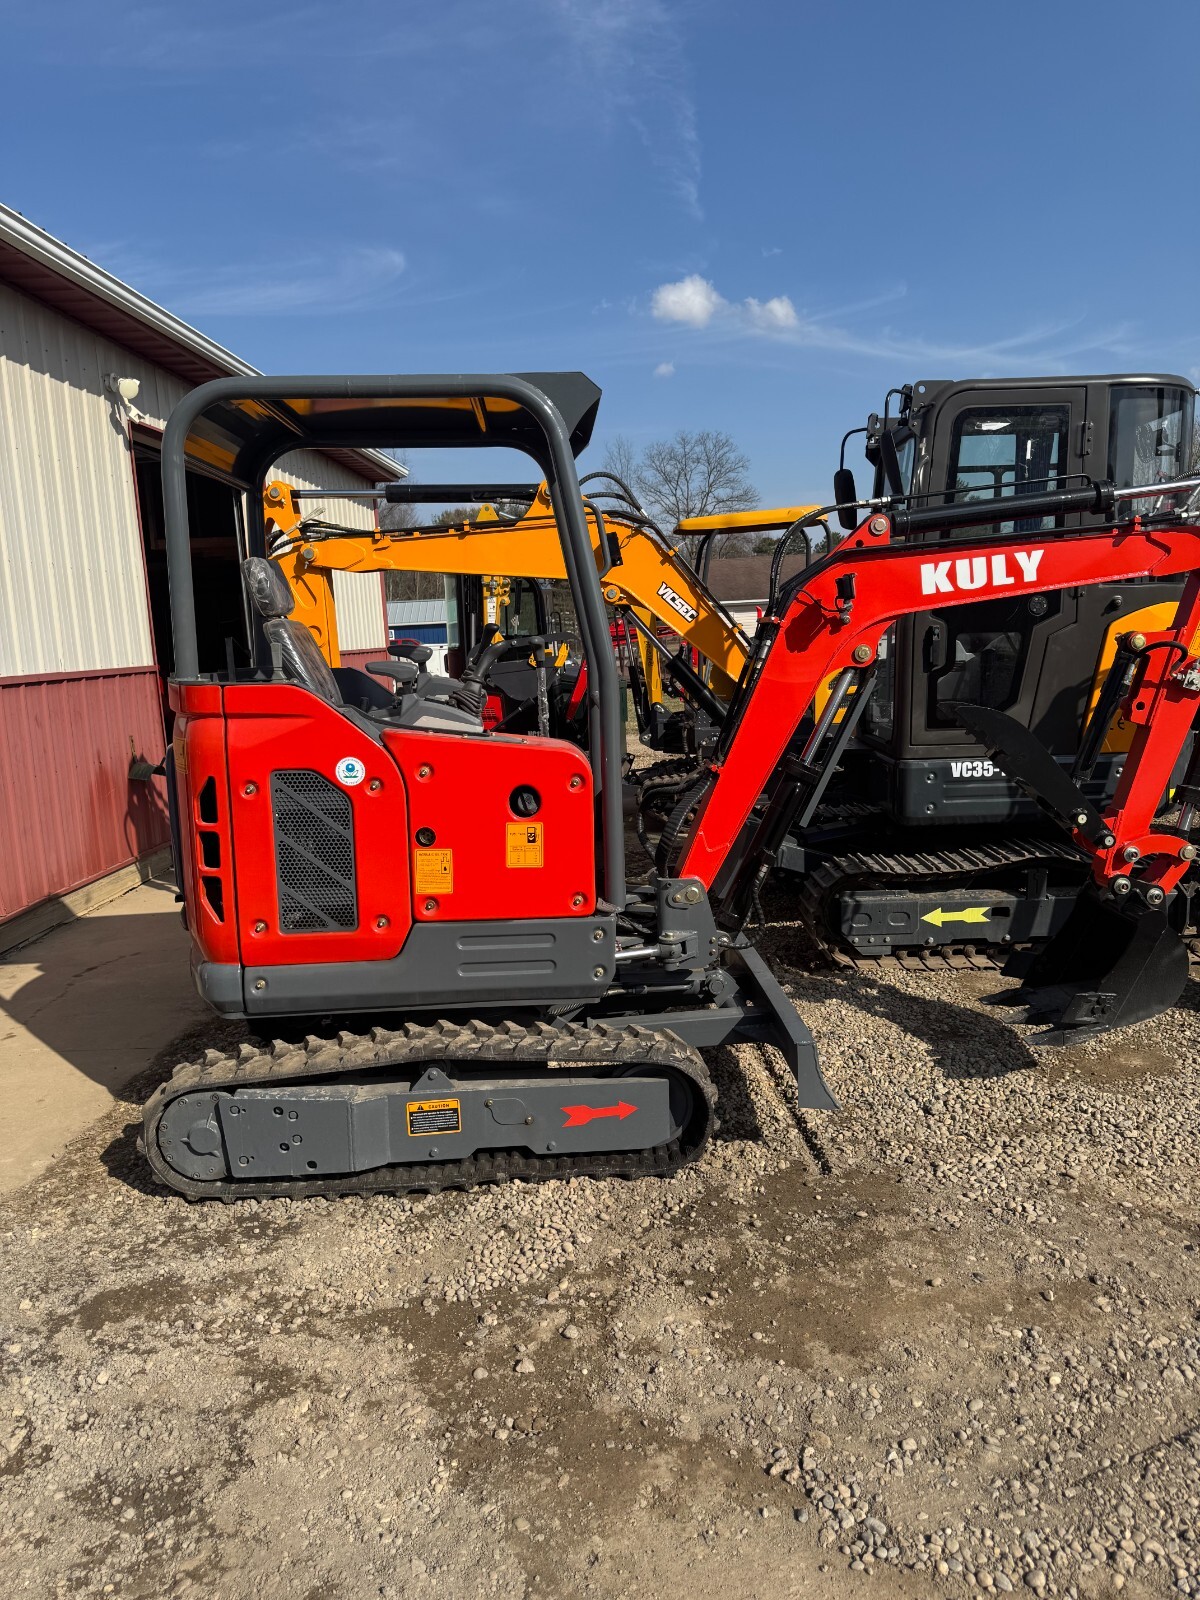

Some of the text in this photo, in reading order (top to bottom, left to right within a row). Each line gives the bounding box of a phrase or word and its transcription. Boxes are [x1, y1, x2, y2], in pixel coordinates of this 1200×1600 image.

[920, 549, 1044, 595] KULY
[656, 581, 699, 623] VICSEC
[951, 761, 1006, 778] VC35-
